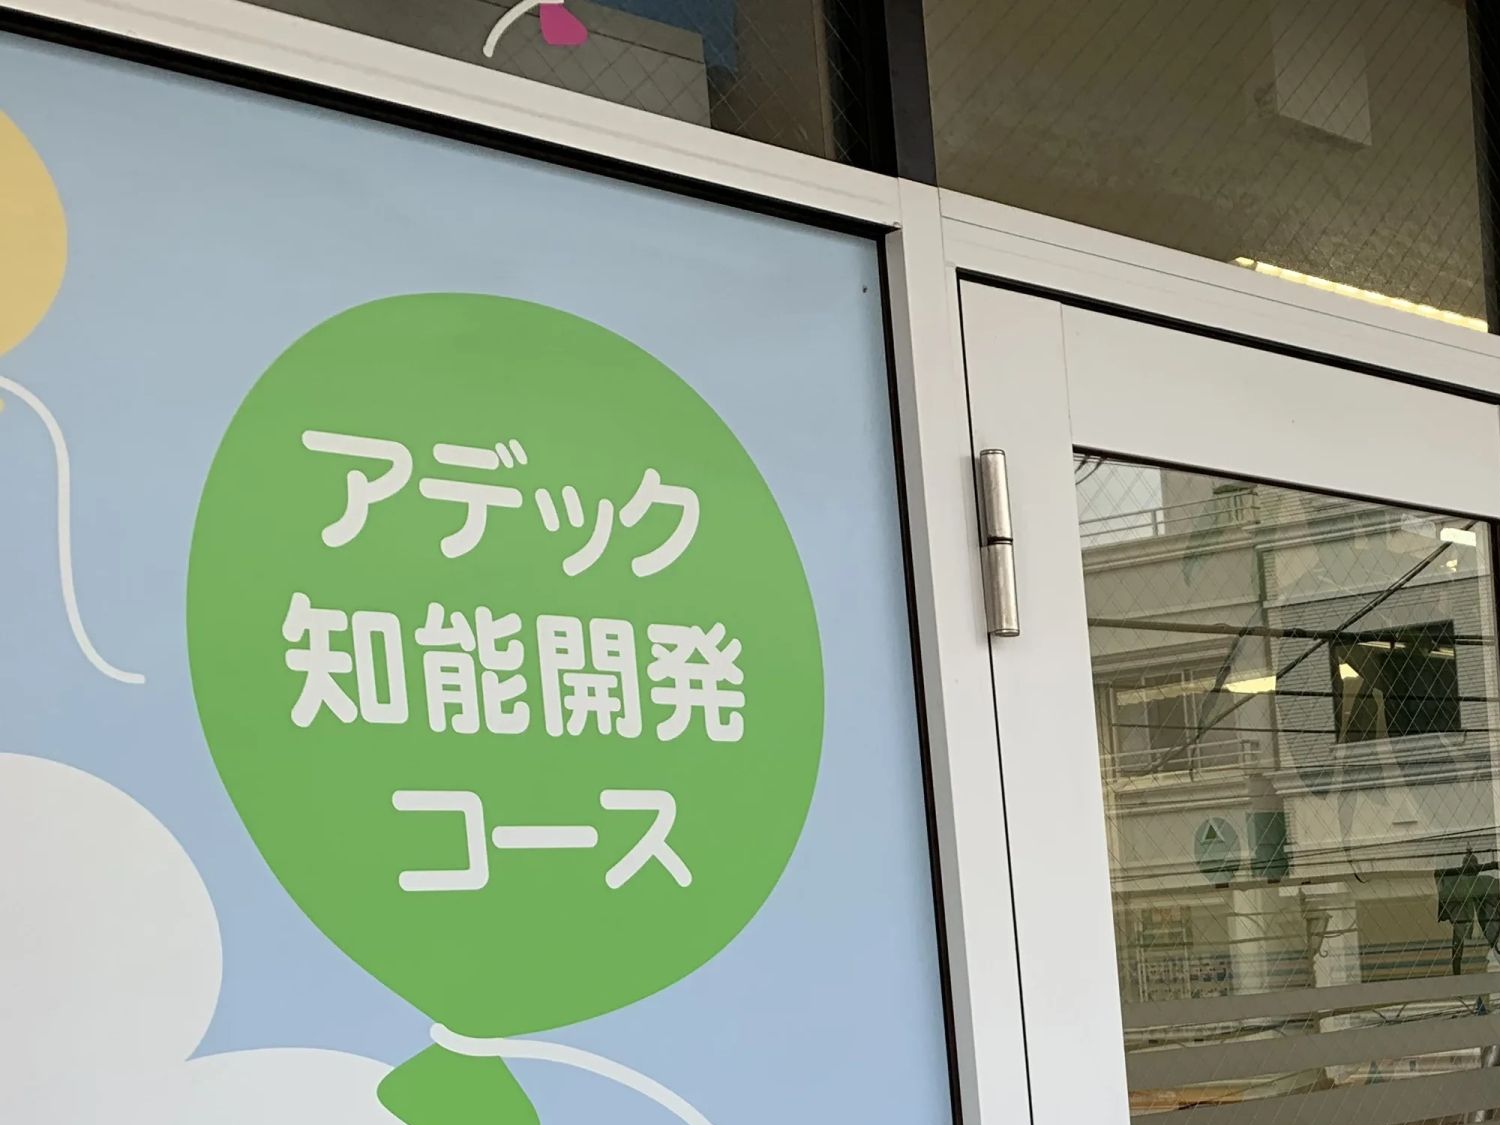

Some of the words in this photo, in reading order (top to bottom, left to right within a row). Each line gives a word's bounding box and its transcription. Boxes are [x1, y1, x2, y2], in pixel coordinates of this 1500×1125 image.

[301, 429, 701, 578] アデック
[282, 592, 745, 743] 知能開発
[392, 788, 693, 891] コース
